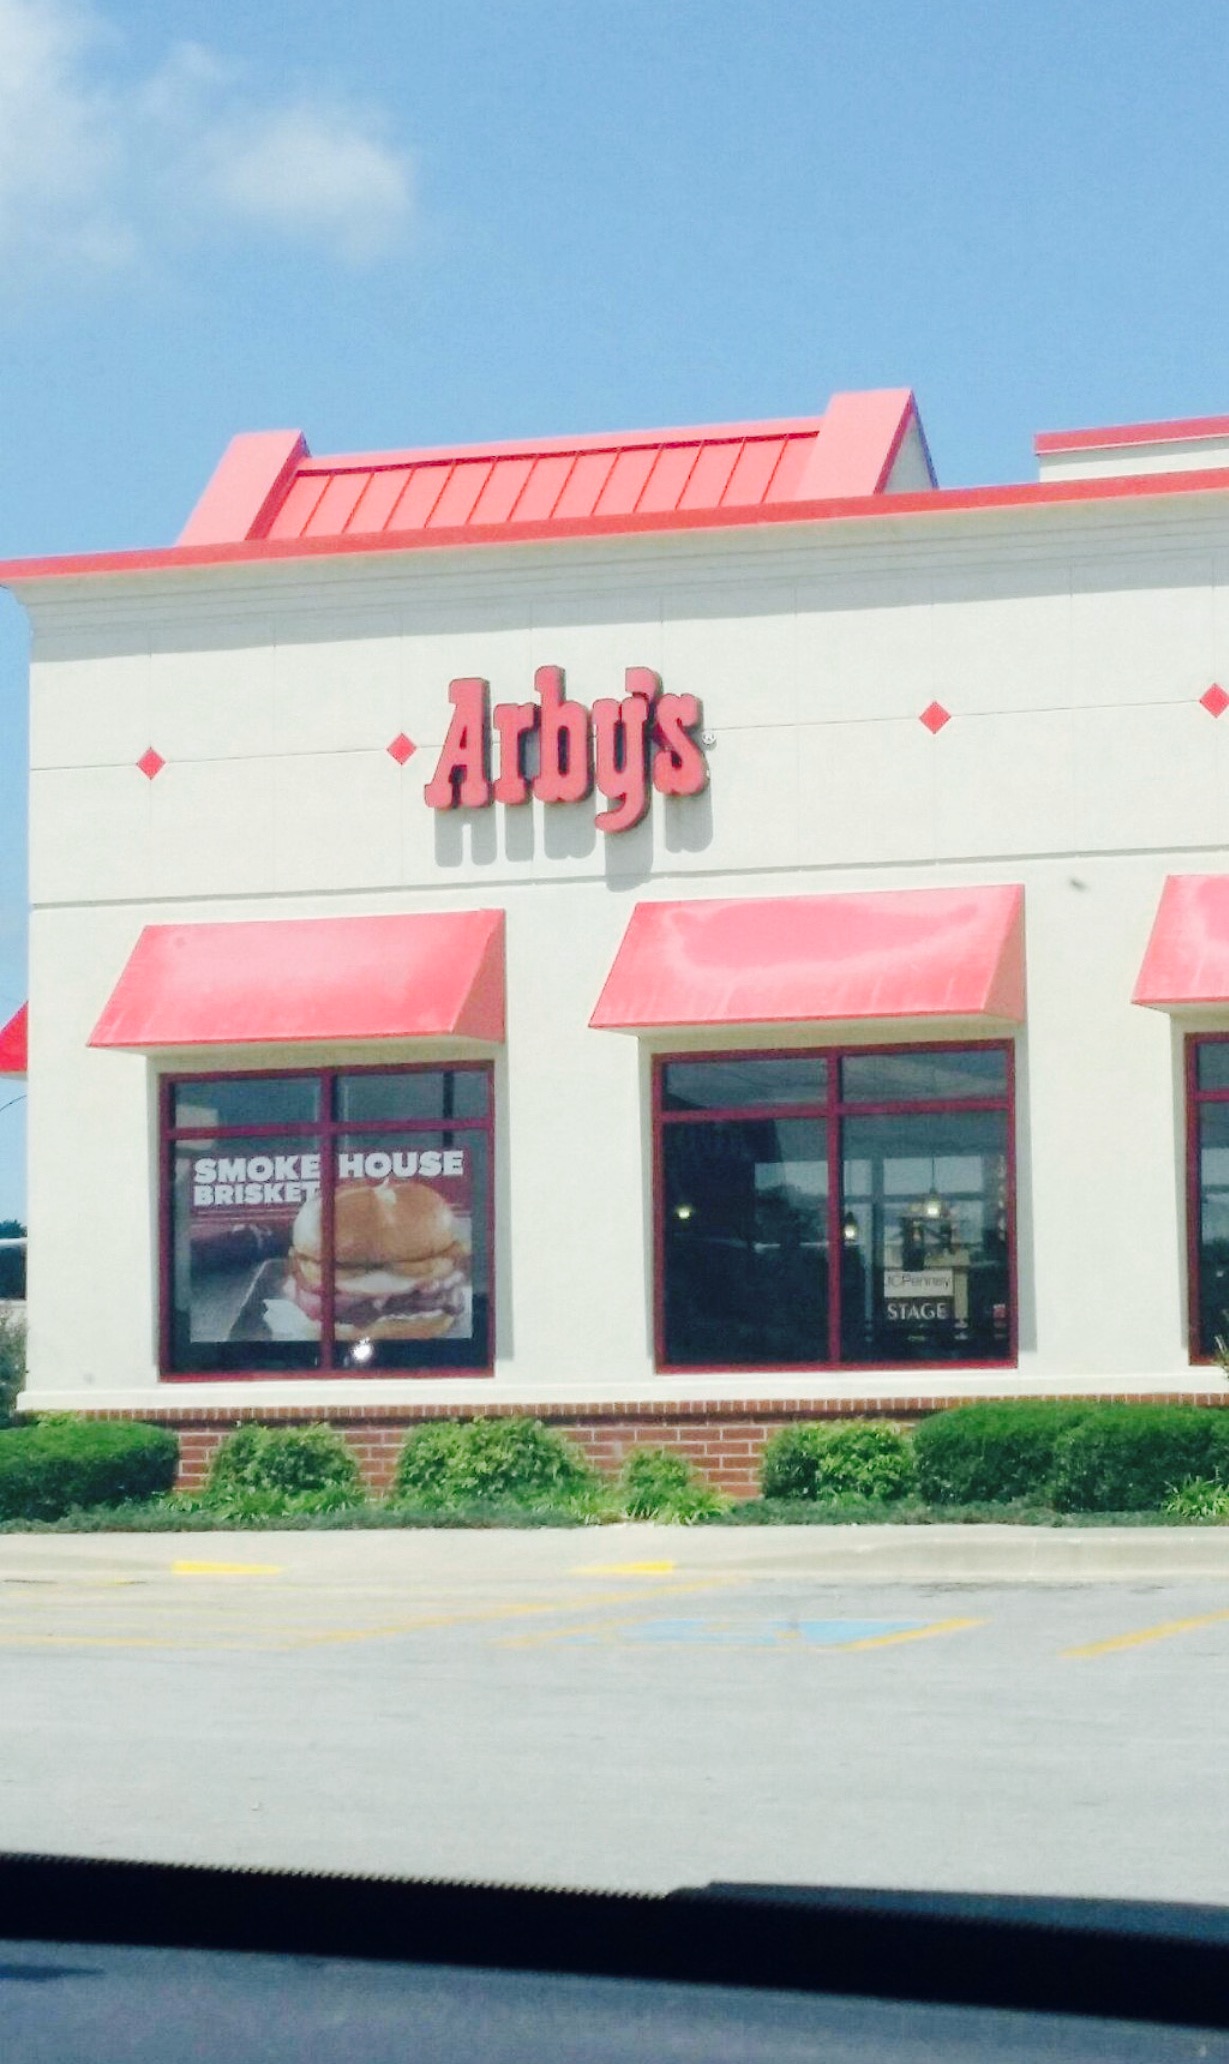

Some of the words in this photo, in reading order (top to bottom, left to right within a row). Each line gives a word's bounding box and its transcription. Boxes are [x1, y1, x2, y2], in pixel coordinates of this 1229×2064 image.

[424, 665, 710, 834] Arby's
[194, 1153, 321, 1183] SMOKE
[338, 1150, 464, 1178] HOUSE
[193, 1180, 321, 1206] BRISKET
[886, 1302, 948, 1320] STAGE
